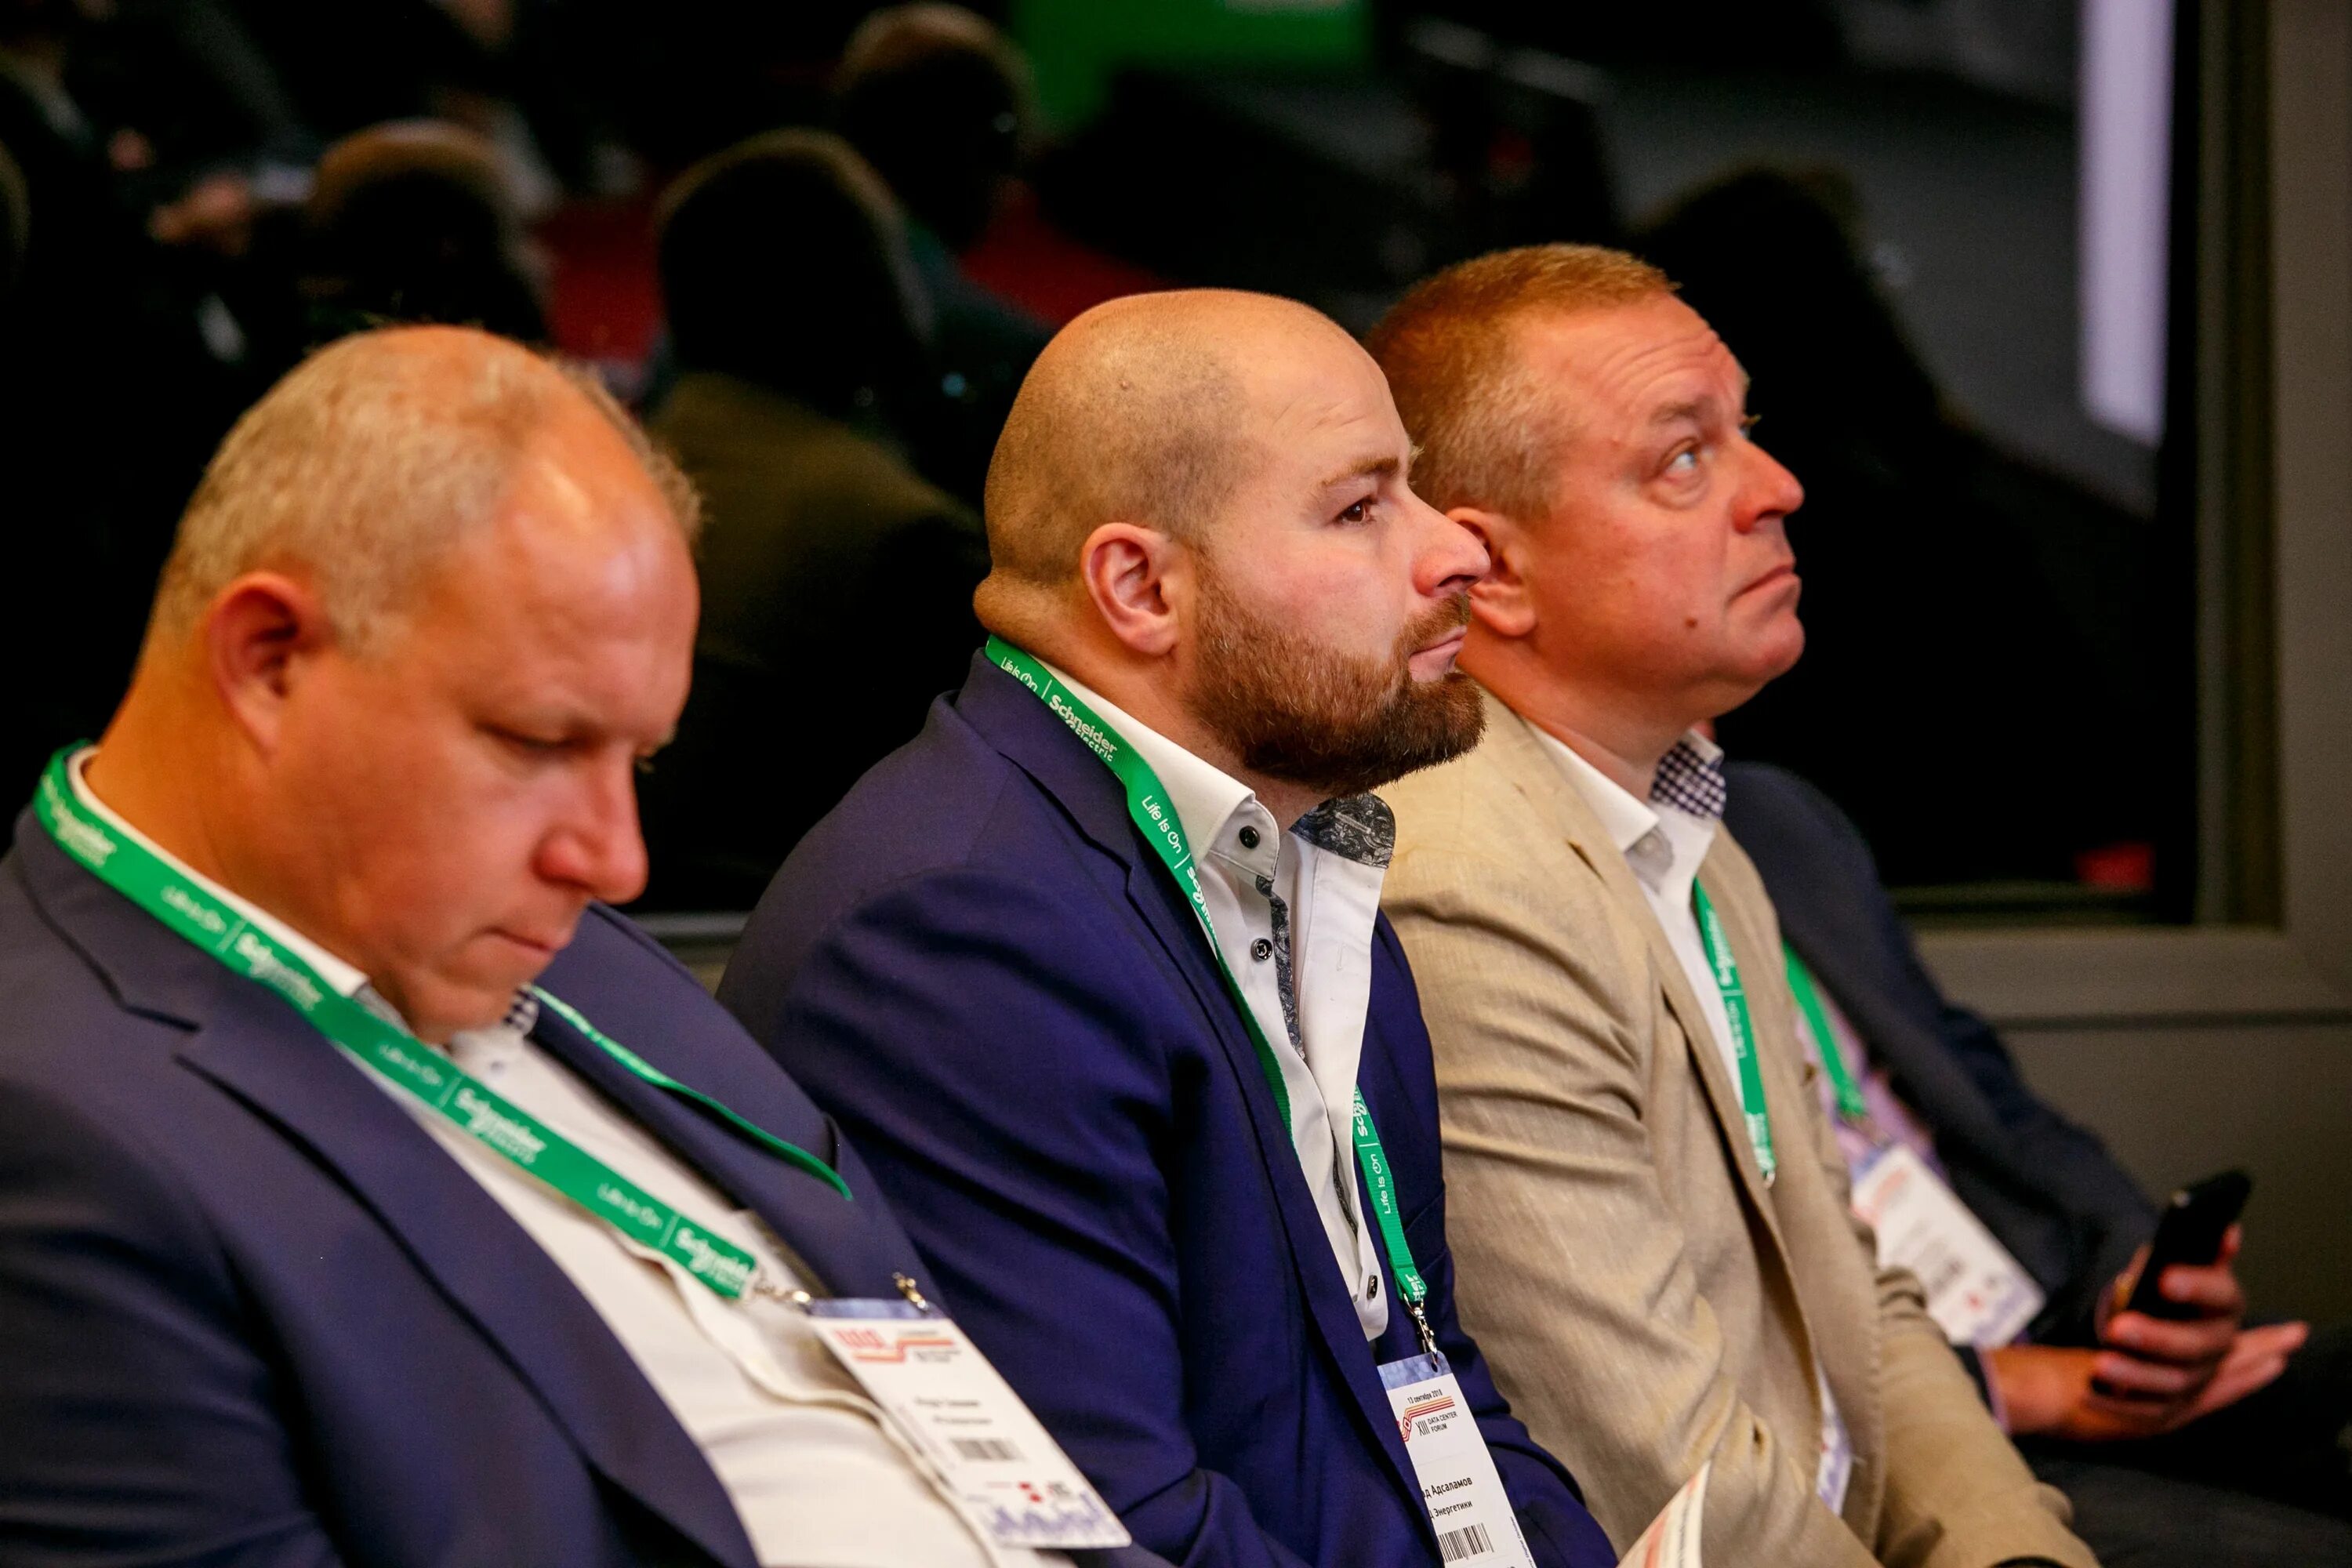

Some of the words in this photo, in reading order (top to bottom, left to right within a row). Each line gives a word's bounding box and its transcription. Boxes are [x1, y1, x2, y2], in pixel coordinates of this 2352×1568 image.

[1049, 695, 1118, 753] Schneider
[1142, 795, 1162, 821] Life
[1157, 818, 1170, 833] Is
[1167, 831, 1182, 854] On
[1370, 1153, 1382, 1174] On
[1377, 1176, 1386, 1188] Is
[1380, 1190, 1392, 1214] Life
[1431, 1388, 1443, 1398] 2018
[1427, 1415, 1440, 1425] DATA
[1439, 1411, 1458, 1421] CENTER
[1431, 1423, 1448, 1433] FORUM
[1431, 1477, 1473, 1497] Адсаламов
[1433, 1501, 1473, 1517] Энергетики
